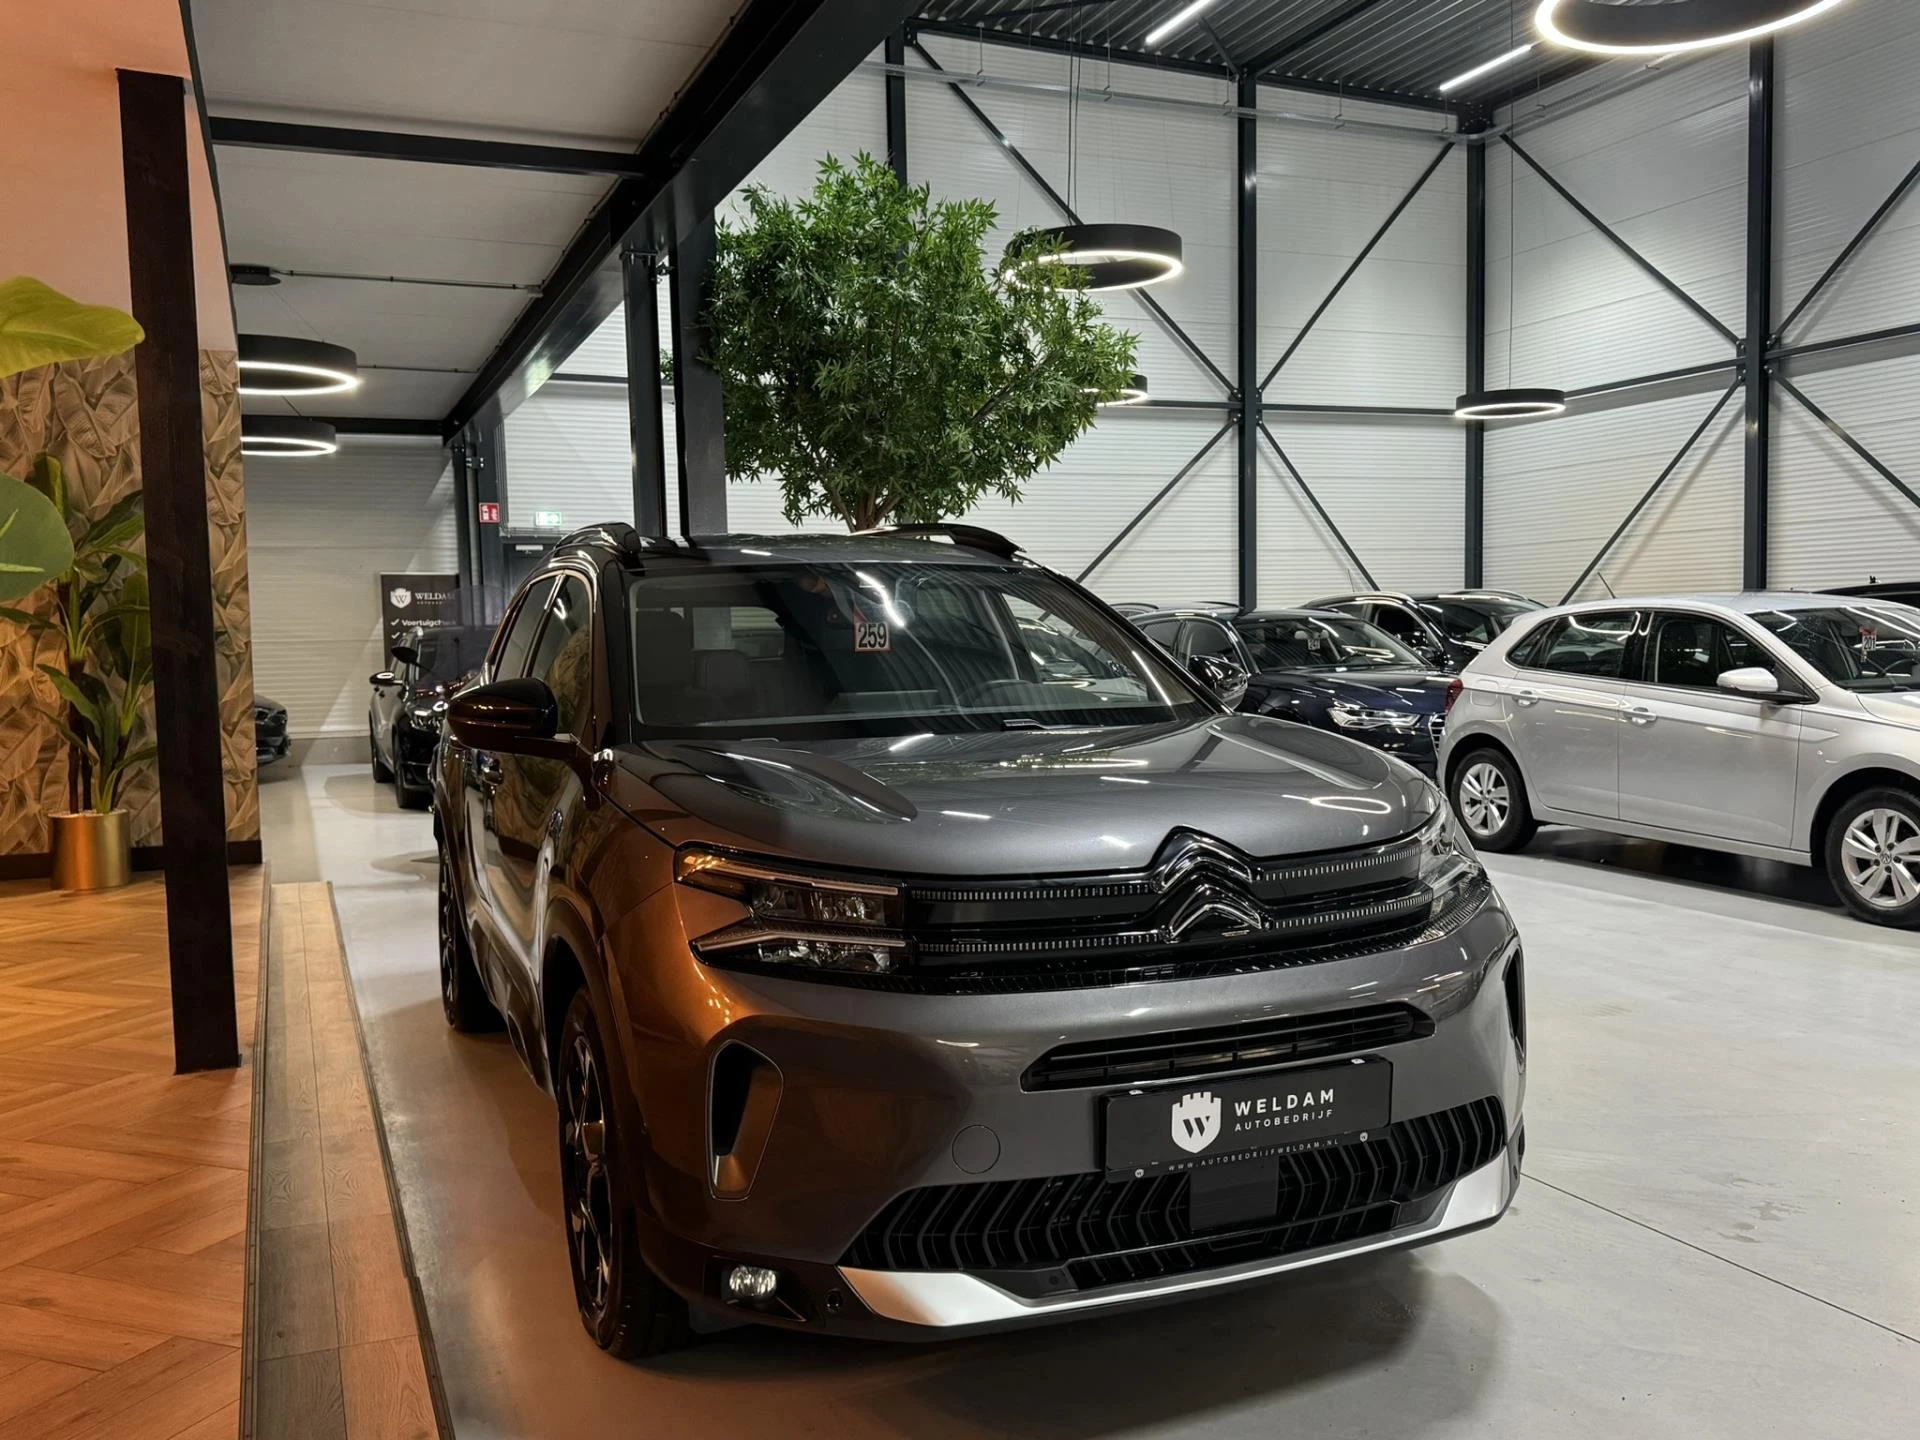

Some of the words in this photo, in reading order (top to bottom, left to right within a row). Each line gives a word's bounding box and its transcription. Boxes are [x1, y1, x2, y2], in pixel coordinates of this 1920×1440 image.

[858, 622, 887, 649] 259
[1234, 1088, 1334, 1117] WELDAM
[1183, 1115, 1211, 1139] W
[1234, 1109, 1334, 1132] AUTOBEDRIJF
[1168, 1138, 1339, 1172] WWW.AUTOBEDRIJFWELDAM.NL
